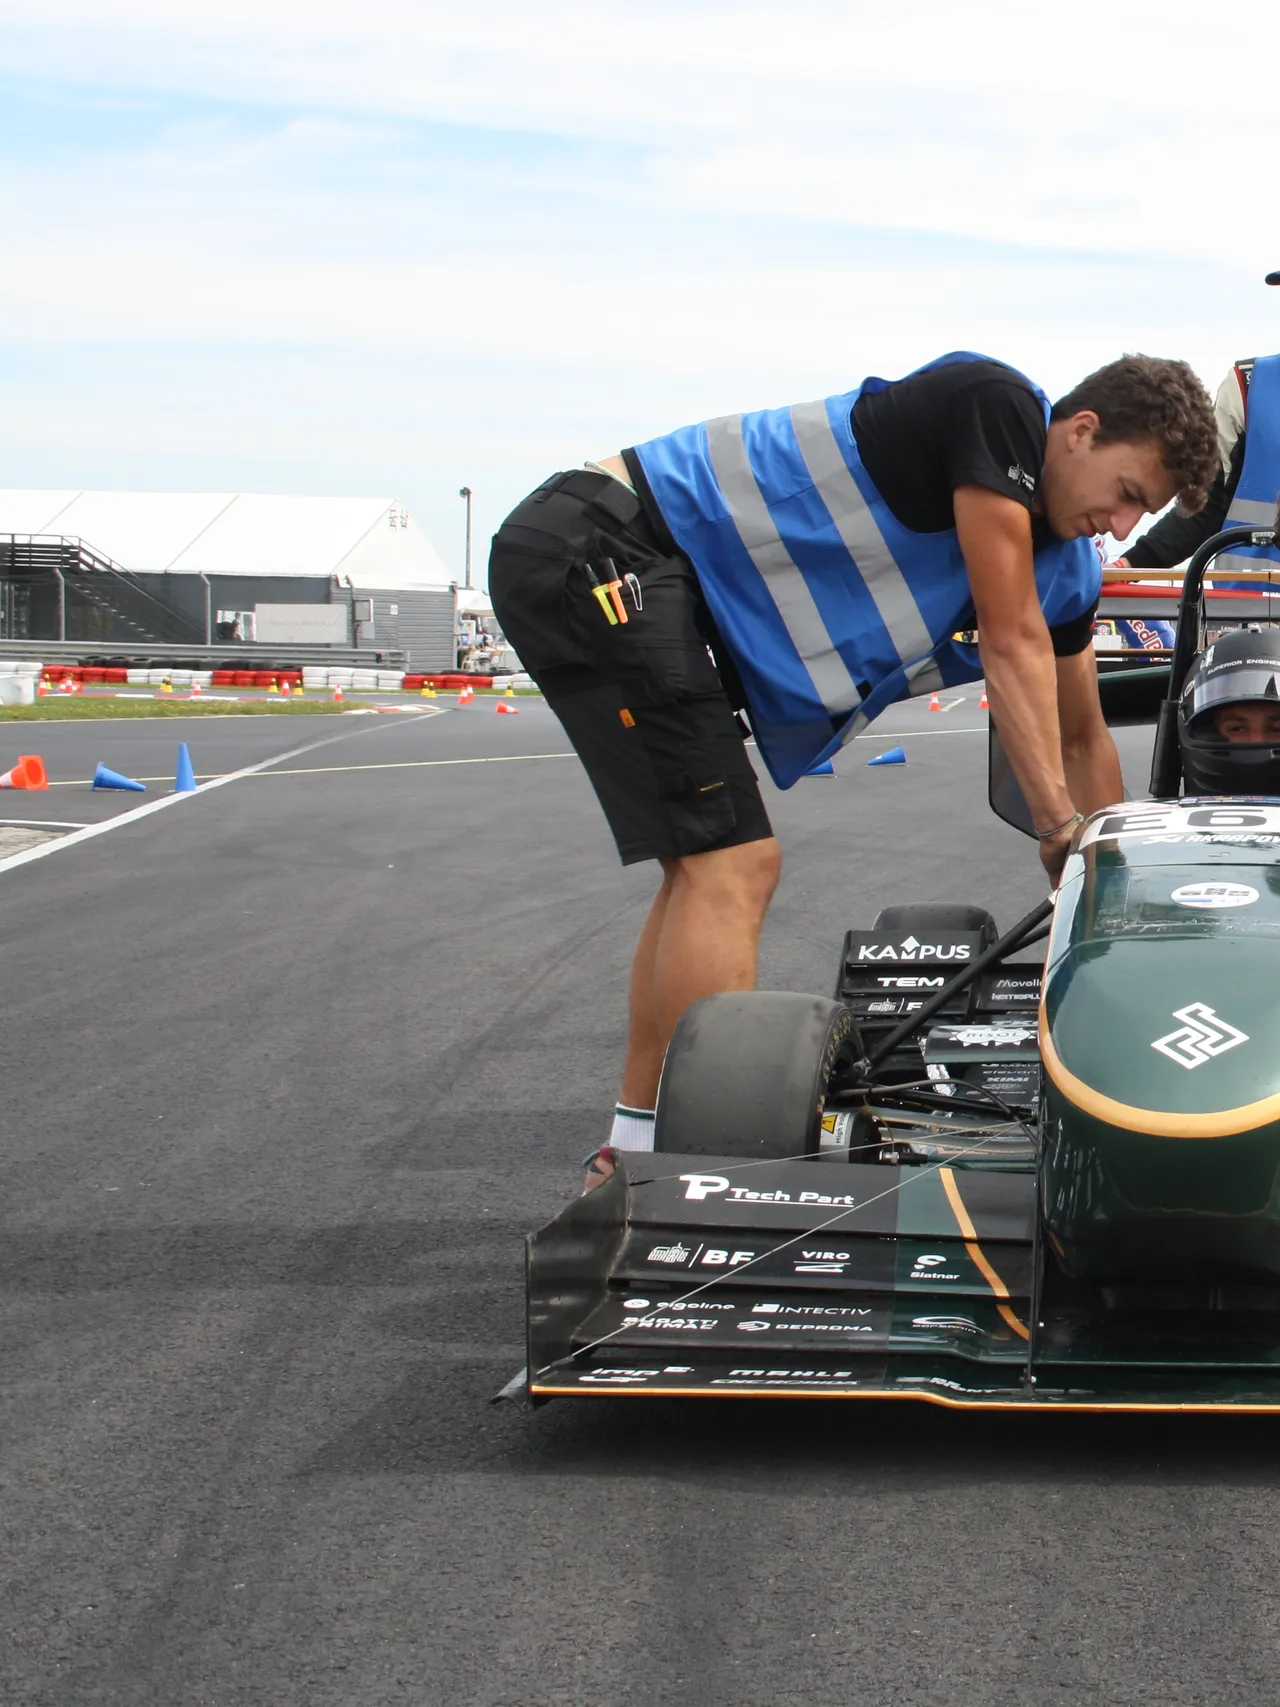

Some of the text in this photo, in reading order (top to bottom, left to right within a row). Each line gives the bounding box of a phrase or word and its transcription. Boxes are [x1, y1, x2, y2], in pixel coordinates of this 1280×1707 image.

[1207, 660, 1242, 675] SUPERIOR
[877, 977, 945, 987] TEM
[730, 1187, 791, 1201] Tech
[799, 1191, 855, 1205] Part
[701, 1249, 755, 1265] BF
[802, 1251, 851, 1260] VIRO
[778, 1307, 872, 1315] INTECTIV
[775, 1323, 873, 1332] DEPROMA
